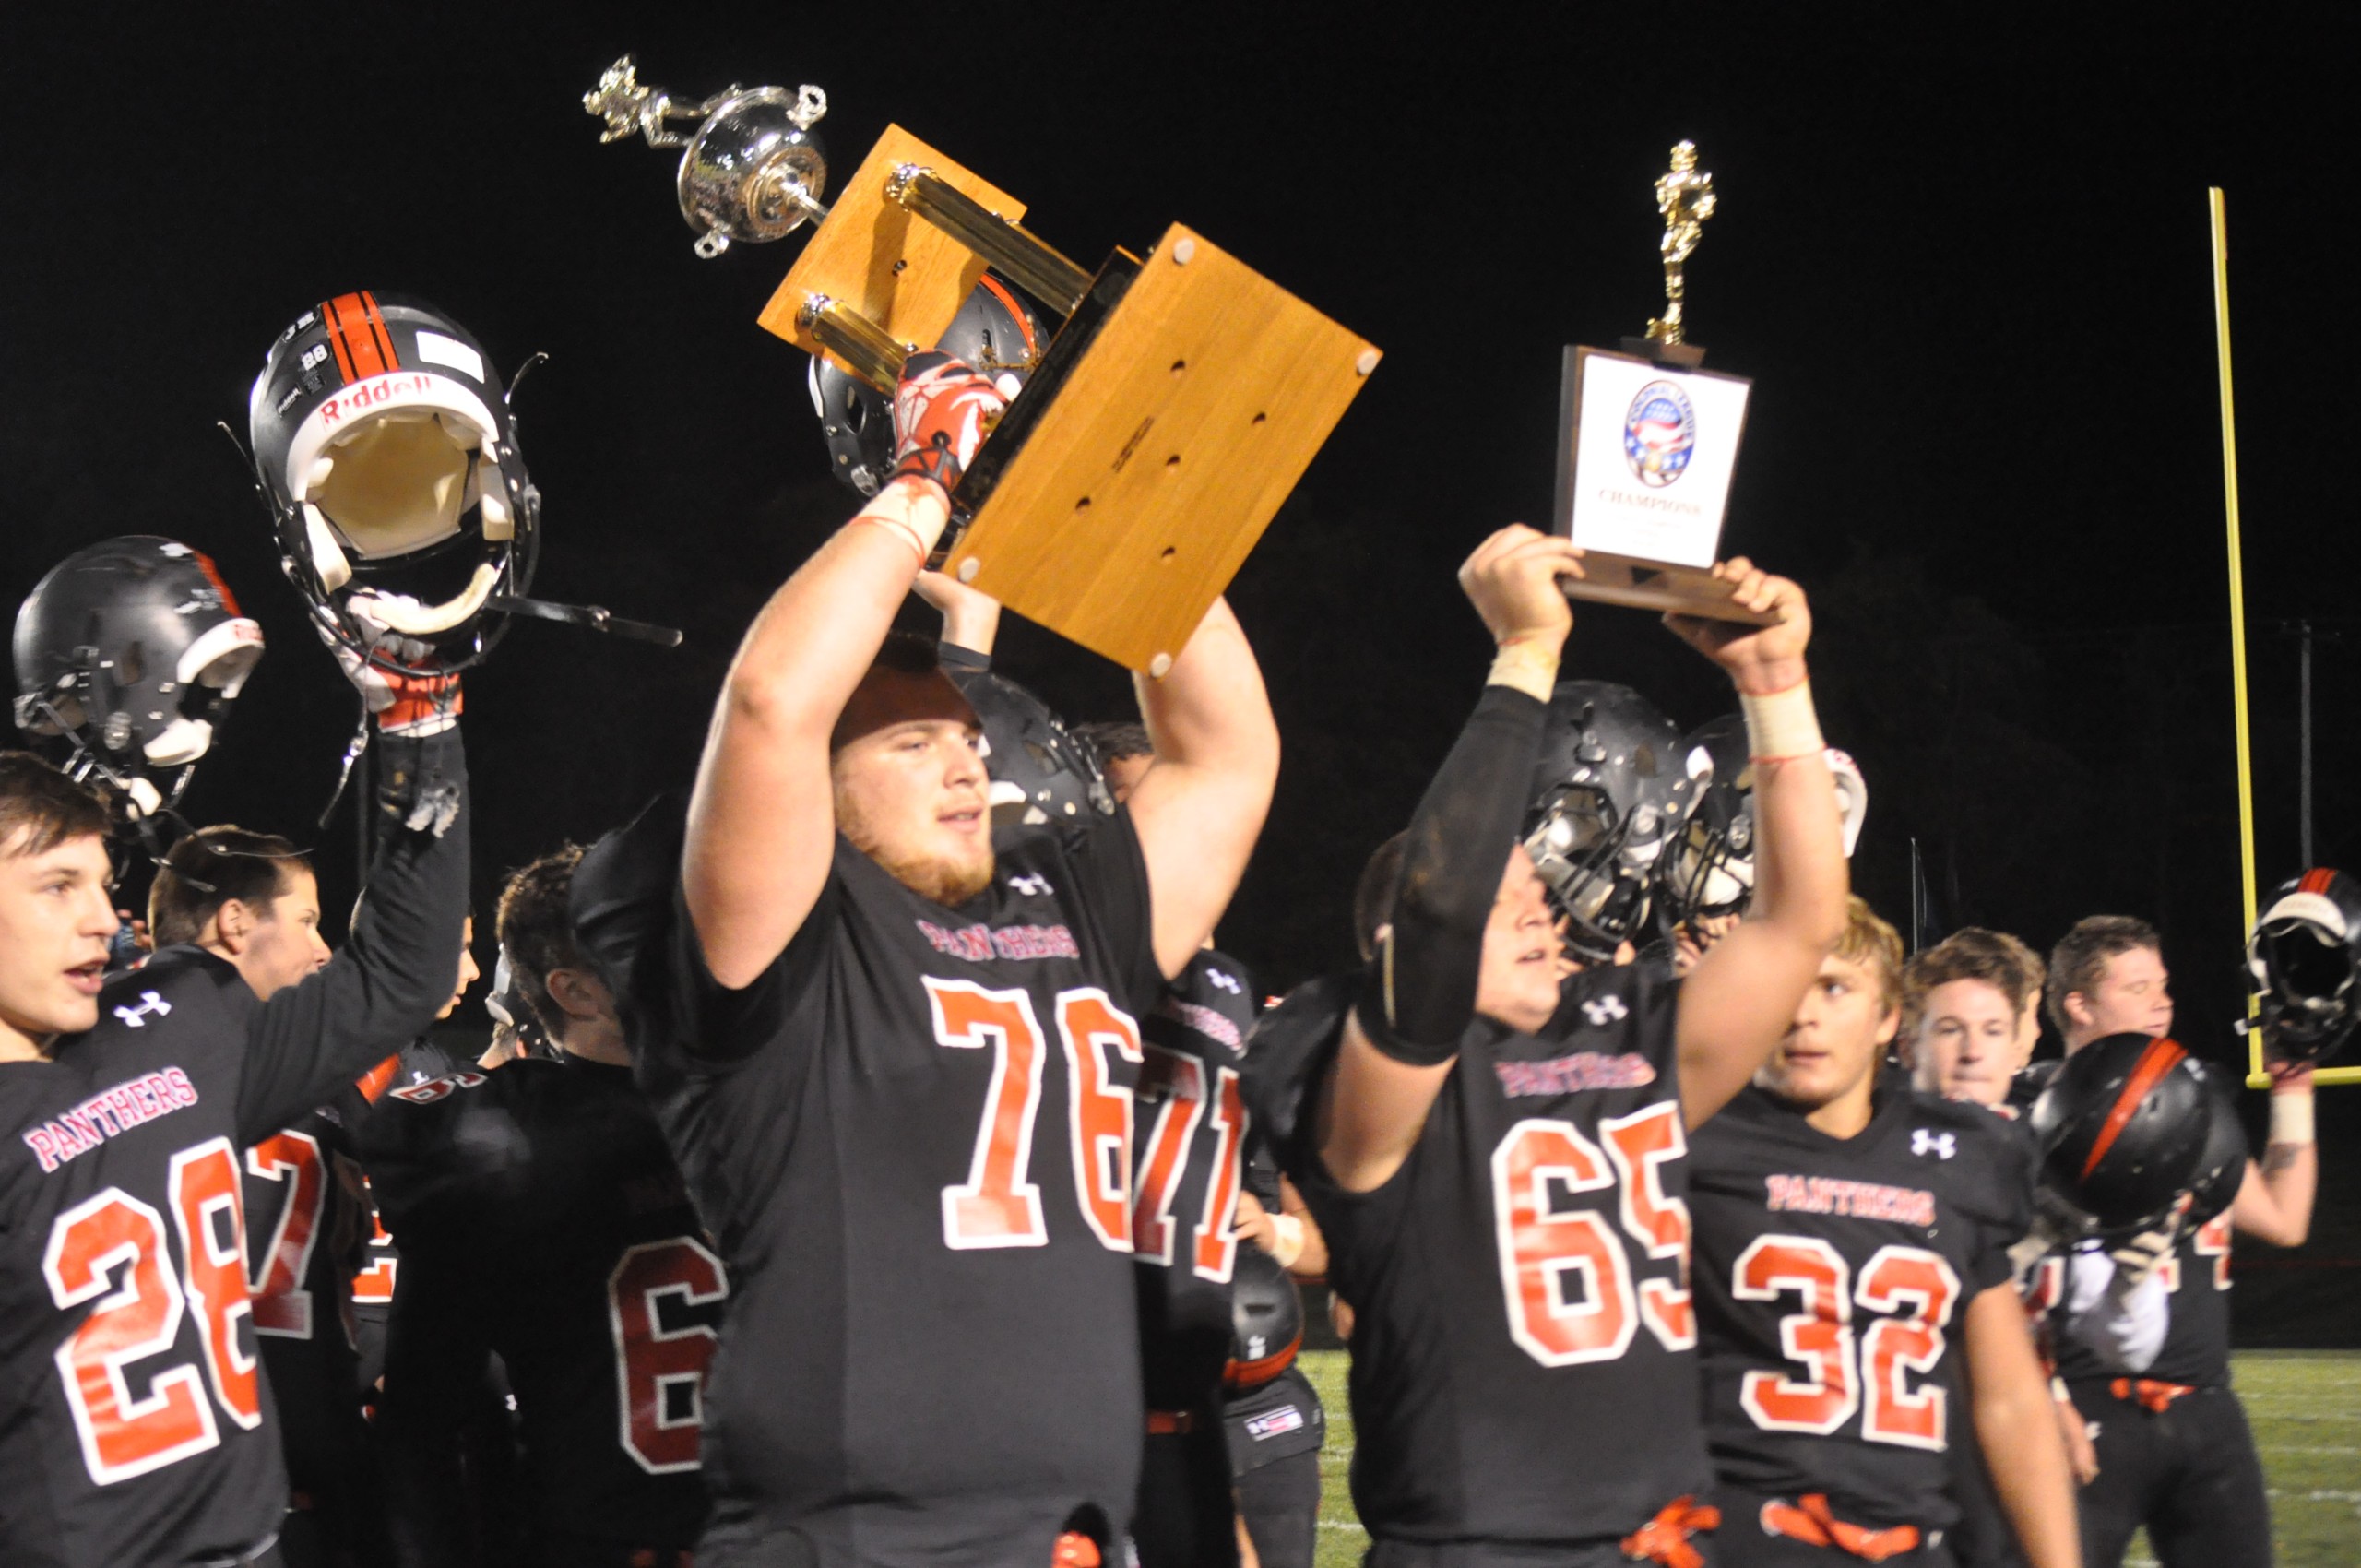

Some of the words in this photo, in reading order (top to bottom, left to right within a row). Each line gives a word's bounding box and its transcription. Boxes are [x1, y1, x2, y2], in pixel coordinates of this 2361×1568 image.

[301, 344, 328, 371] 28
[320, 376, 431, 424] Riddell
[1598, 487, 1702, 517] CHAMPIONS
[22, 1065, 198, 1173] PANTHERS
[922, 974, 1144, 1253] 76
[1132, 1040, 1245, 1285] 71
[1491, 1100, 1699, 1368] 65
[1765, 1174, 1937, 1228] PANTHERS
[43, 1135, 263, 1487] 28
[1733, 1234, 1961, 1452] 32
